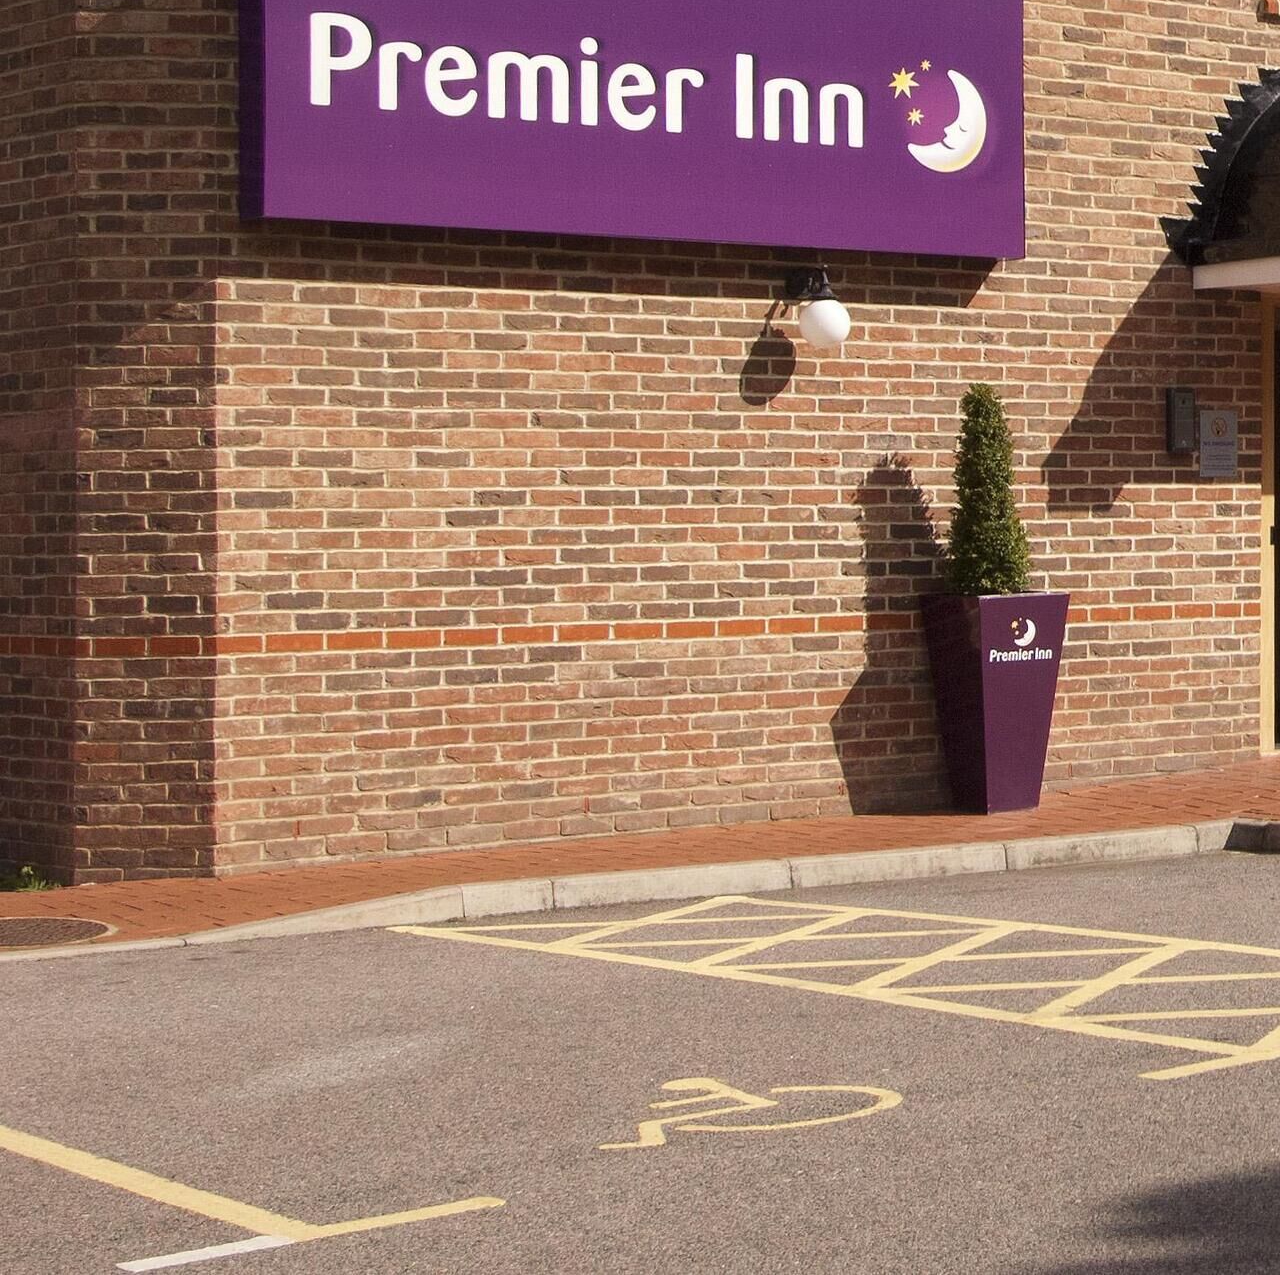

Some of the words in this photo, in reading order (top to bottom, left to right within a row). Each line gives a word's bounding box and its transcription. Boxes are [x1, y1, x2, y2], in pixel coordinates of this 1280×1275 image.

[310, 12, 704, 133] Premier
[736, 53, 864, 148] Inn
[989, 648, 1035, 663] Premier
[1034, 647, 1053, 660] Inn
